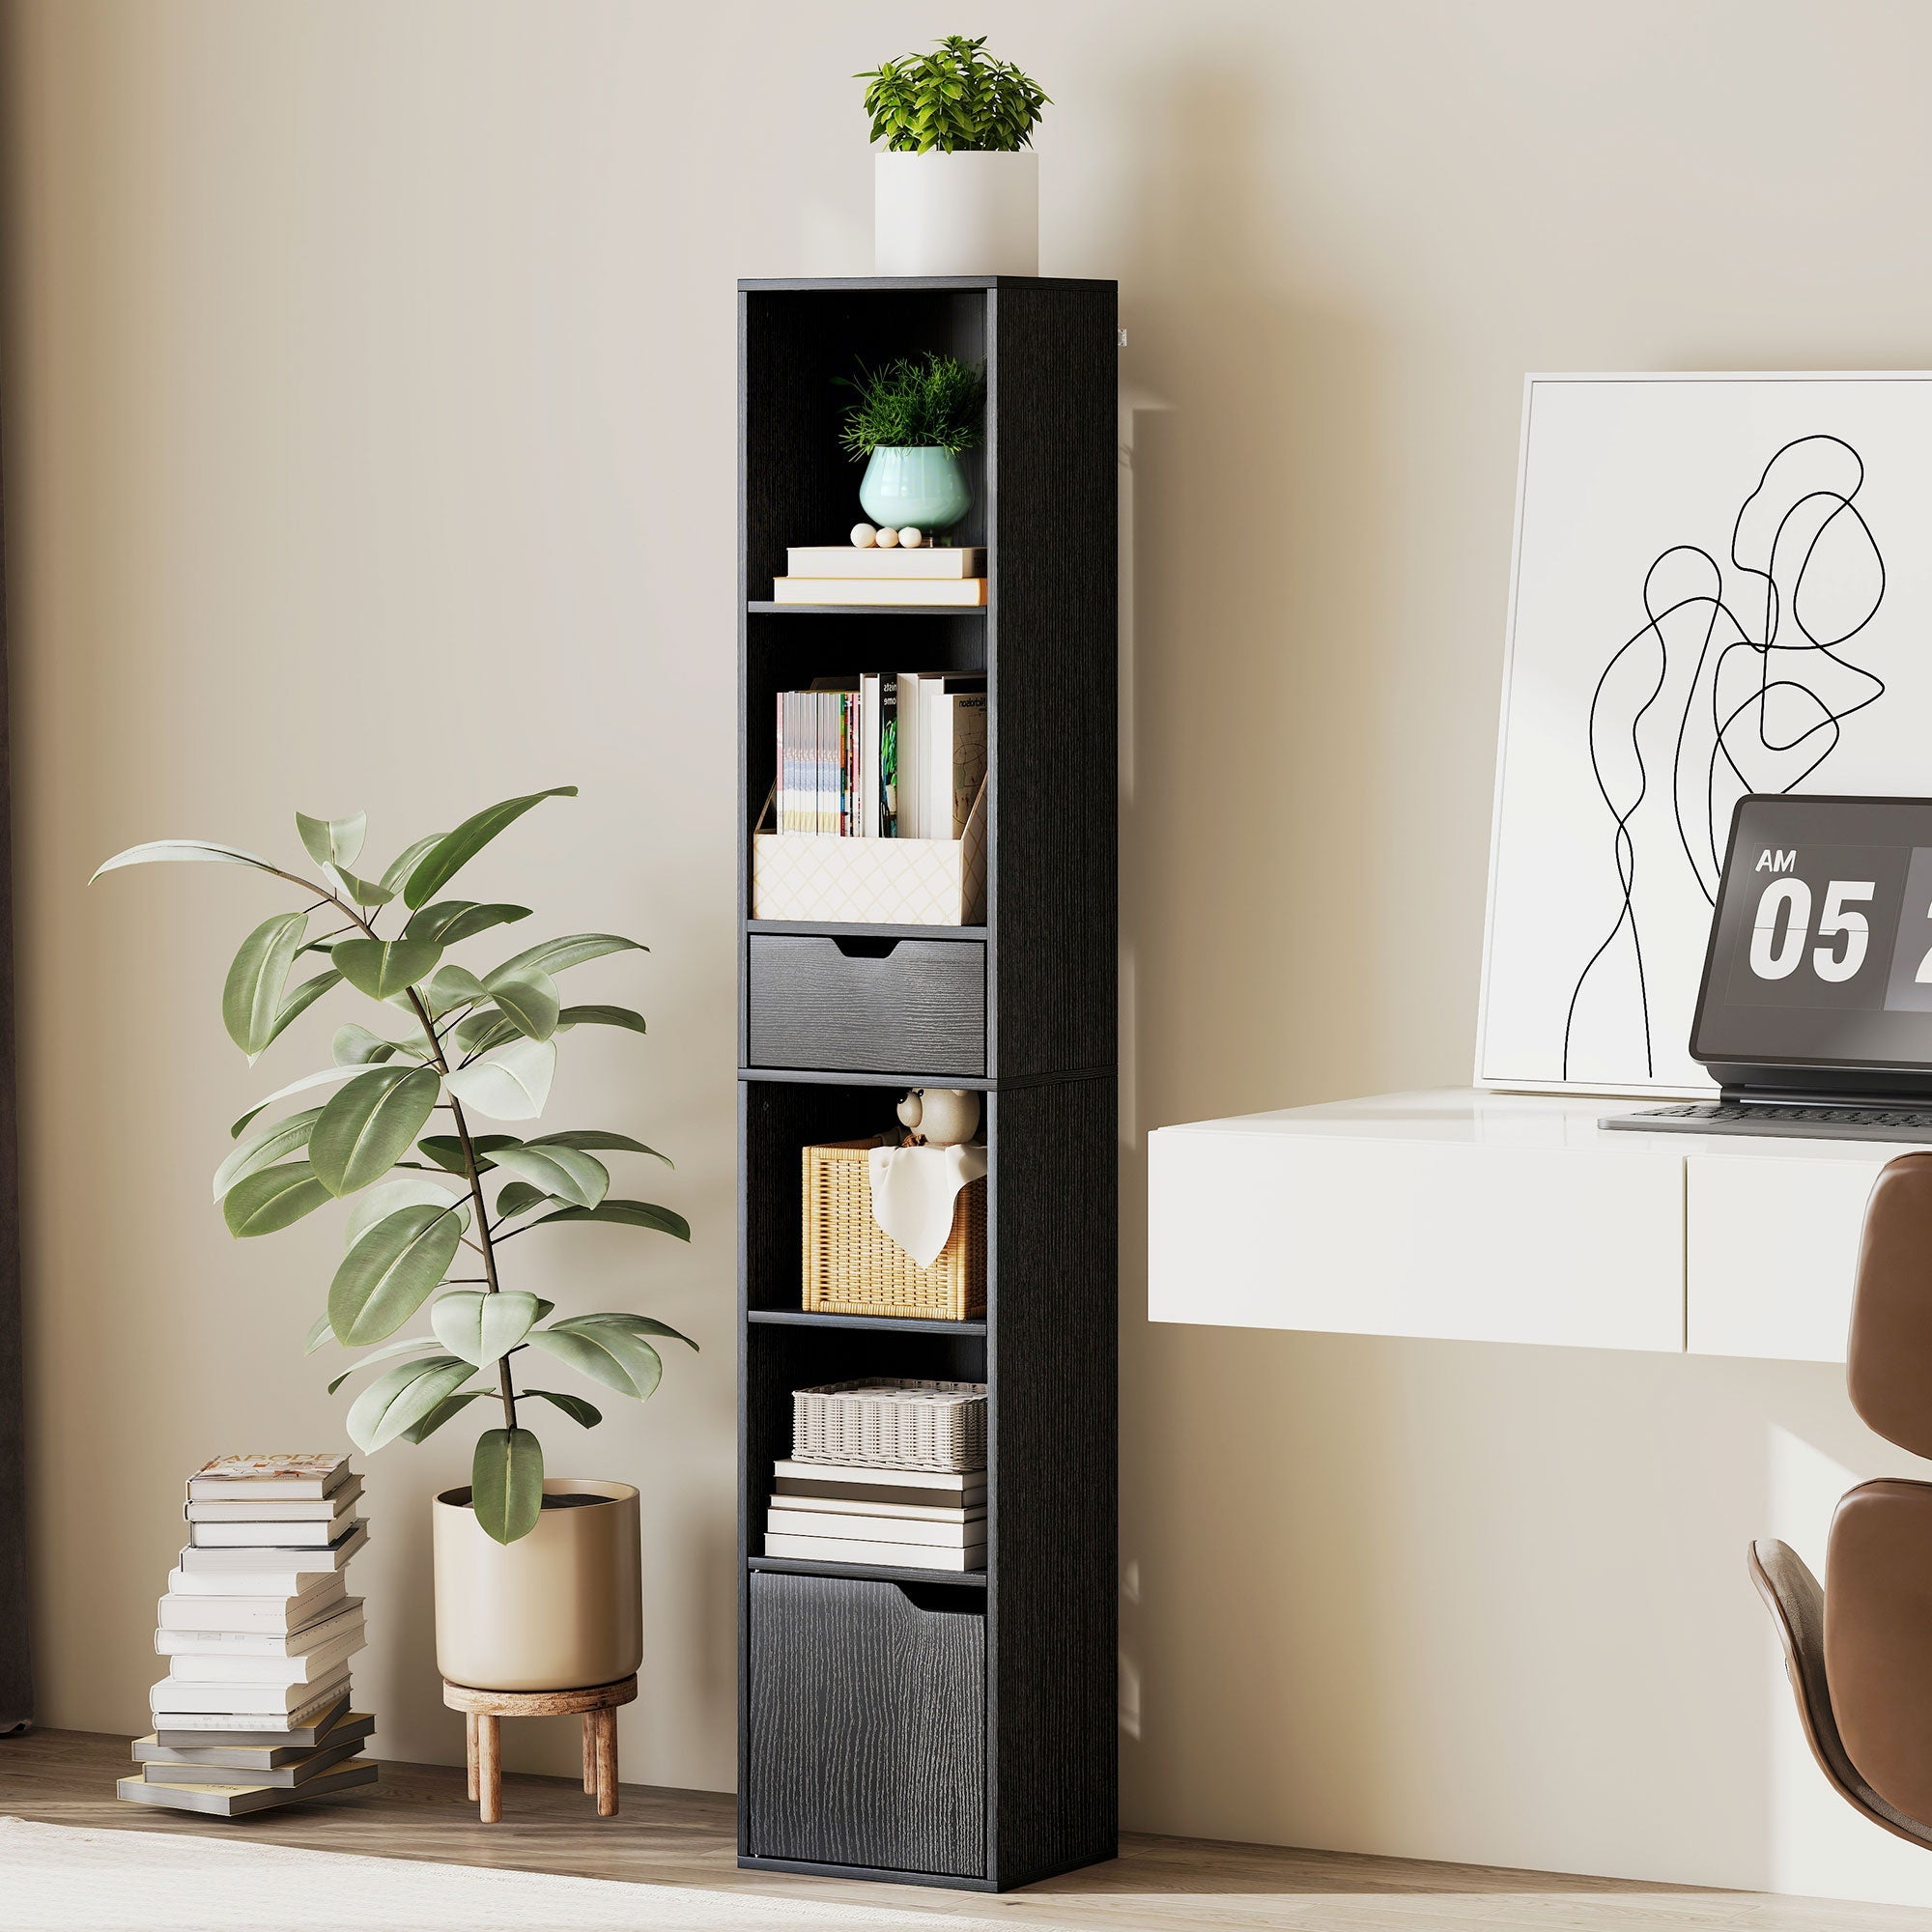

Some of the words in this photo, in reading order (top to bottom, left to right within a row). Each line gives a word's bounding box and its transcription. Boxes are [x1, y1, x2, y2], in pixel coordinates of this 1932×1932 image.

[1754, 849, 1797, 872] AM
[1749, 877, 1876, 983] 05
[222, 1453, 339, 1462] ABODE
